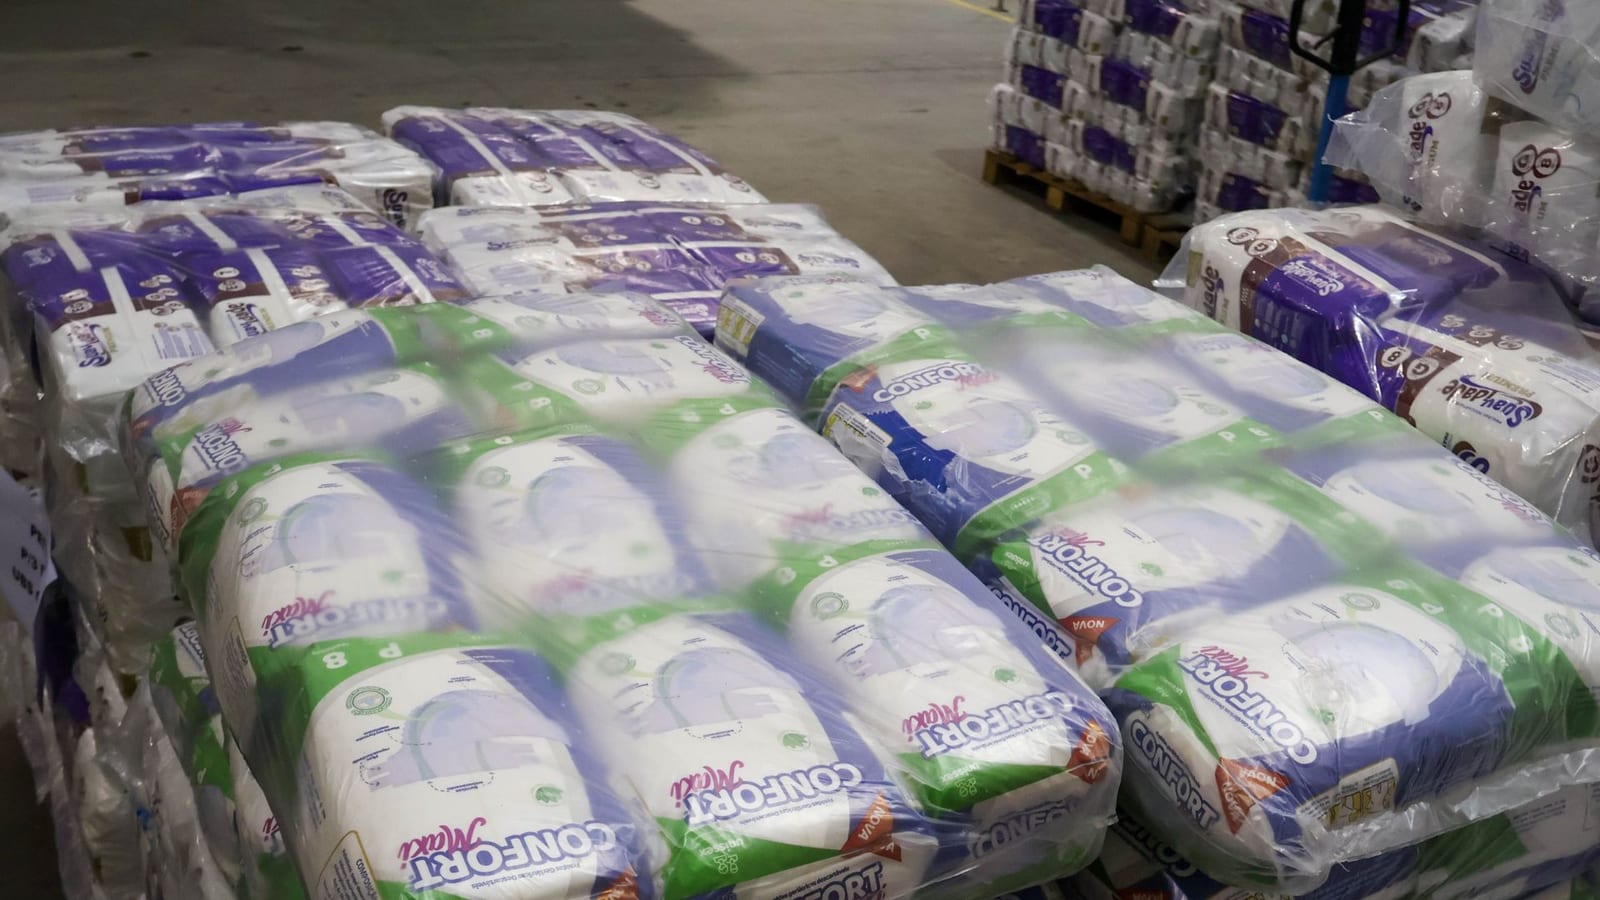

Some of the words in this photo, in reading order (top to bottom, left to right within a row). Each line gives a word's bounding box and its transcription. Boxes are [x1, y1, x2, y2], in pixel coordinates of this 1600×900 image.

[1026, 533, 1143, 608] CONFORT
[1072, 619, 1105, 631] NOVA
[322, 651, 348, 670] 8
[917, 689, 1075, 760] CONFORT
[1176, 653, 1318, 766] CONFORT
[669, 760, 745, 809] Maxi
[684, 762, 864, 828] CONFORT
[1130, 718, 1221, 832] CONFORT
[398, 816, 487, 870] Maxi
[407, 821, 618, 893] CONFORT
